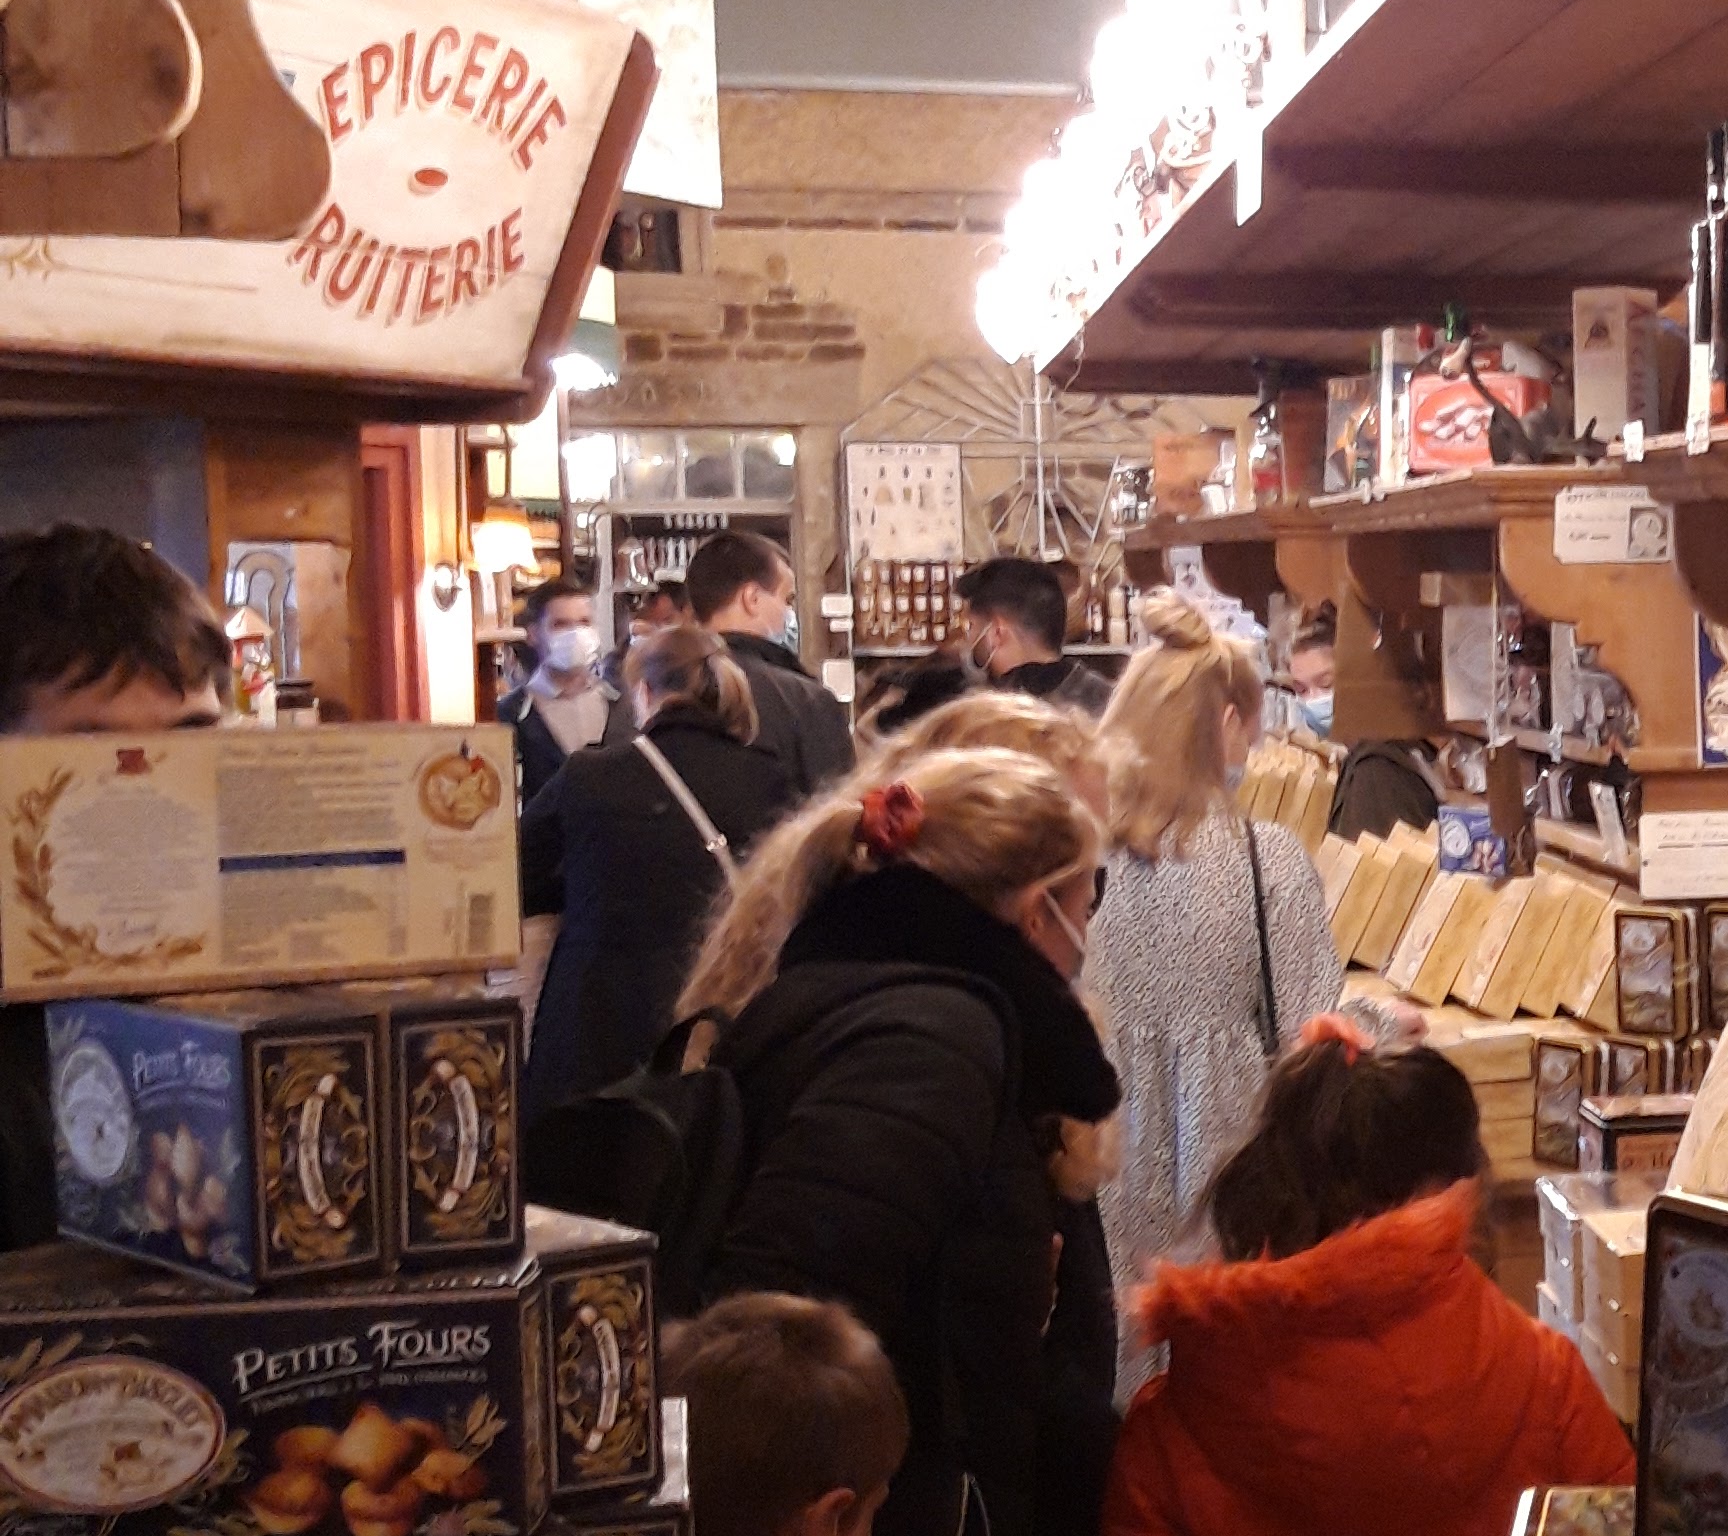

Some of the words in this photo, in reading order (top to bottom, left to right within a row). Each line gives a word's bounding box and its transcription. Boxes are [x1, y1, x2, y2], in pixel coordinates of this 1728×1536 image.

[320, 26, 567, 172] EPICERIE
[290, 204, 527, 327] RUITERIE
[232, 1336, 359, 1395] PETITS
[366, 1319, 492, 1370] FOURS
